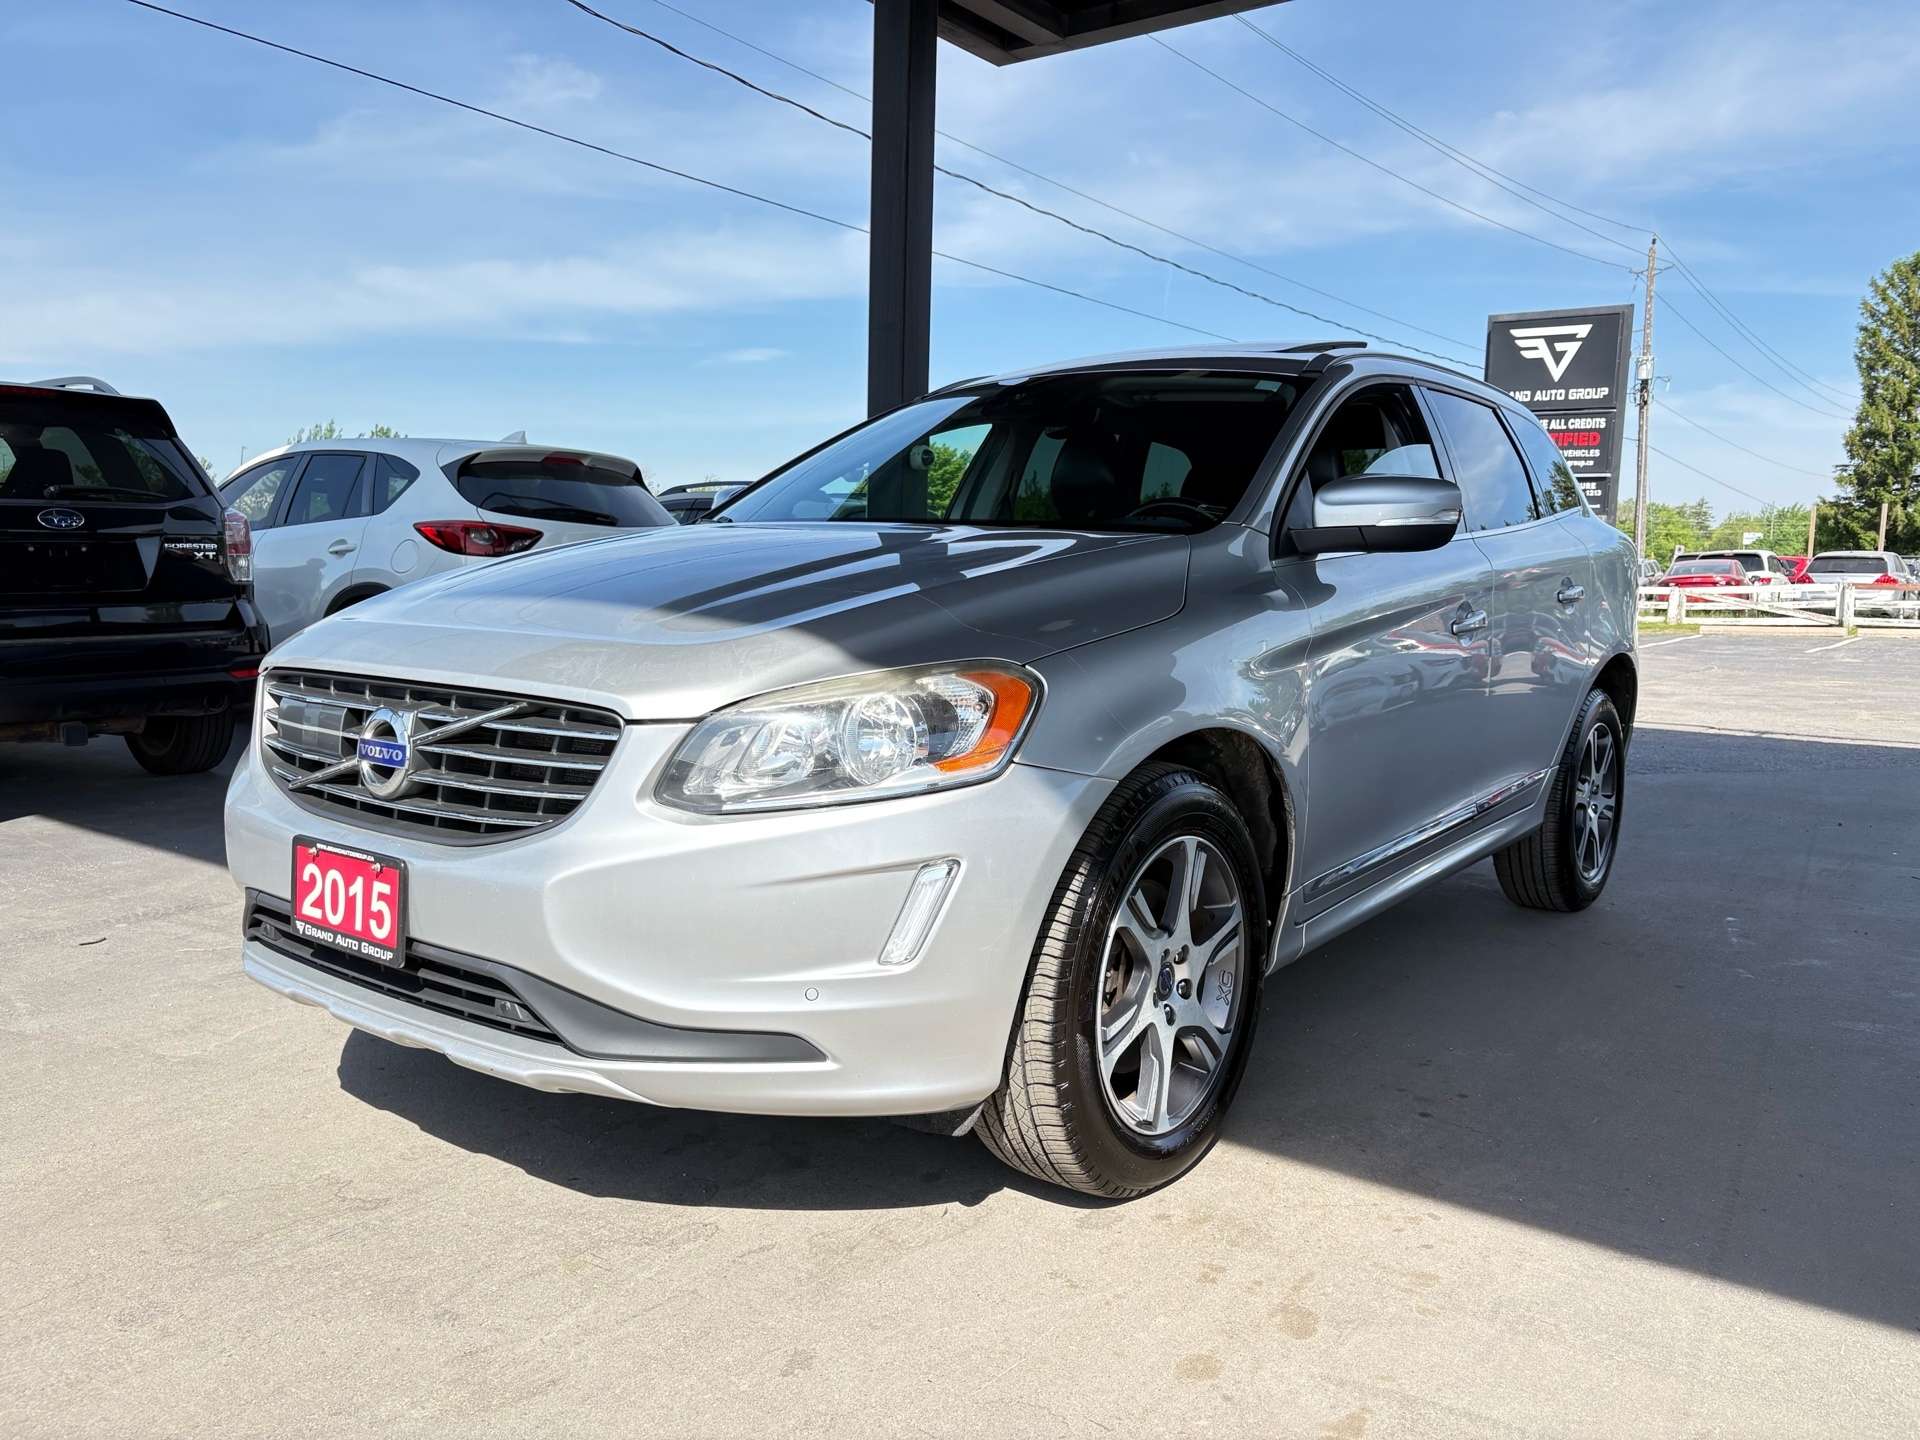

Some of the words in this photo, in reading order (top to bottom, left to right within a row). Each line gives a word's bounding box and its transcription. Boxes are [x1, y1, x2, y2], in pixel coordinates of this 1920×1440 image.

[1534, 389, 1566, 401] AUTO
[1568, 387, 1609, 400] GROUP
[1549, 419, 1567, 430] ALL
[1568, 418, 1606, 429] CREDITS
[1563, 449, 1601, 458] VEHICLES
[164, 543, 218, 551] FORESTER
[193, 552, 217, 561] XT
[360, 744, 403, 761] VOLVO
[301, 863, 392, 940] 2015
[1216, 969, 1233, 1006] XC
